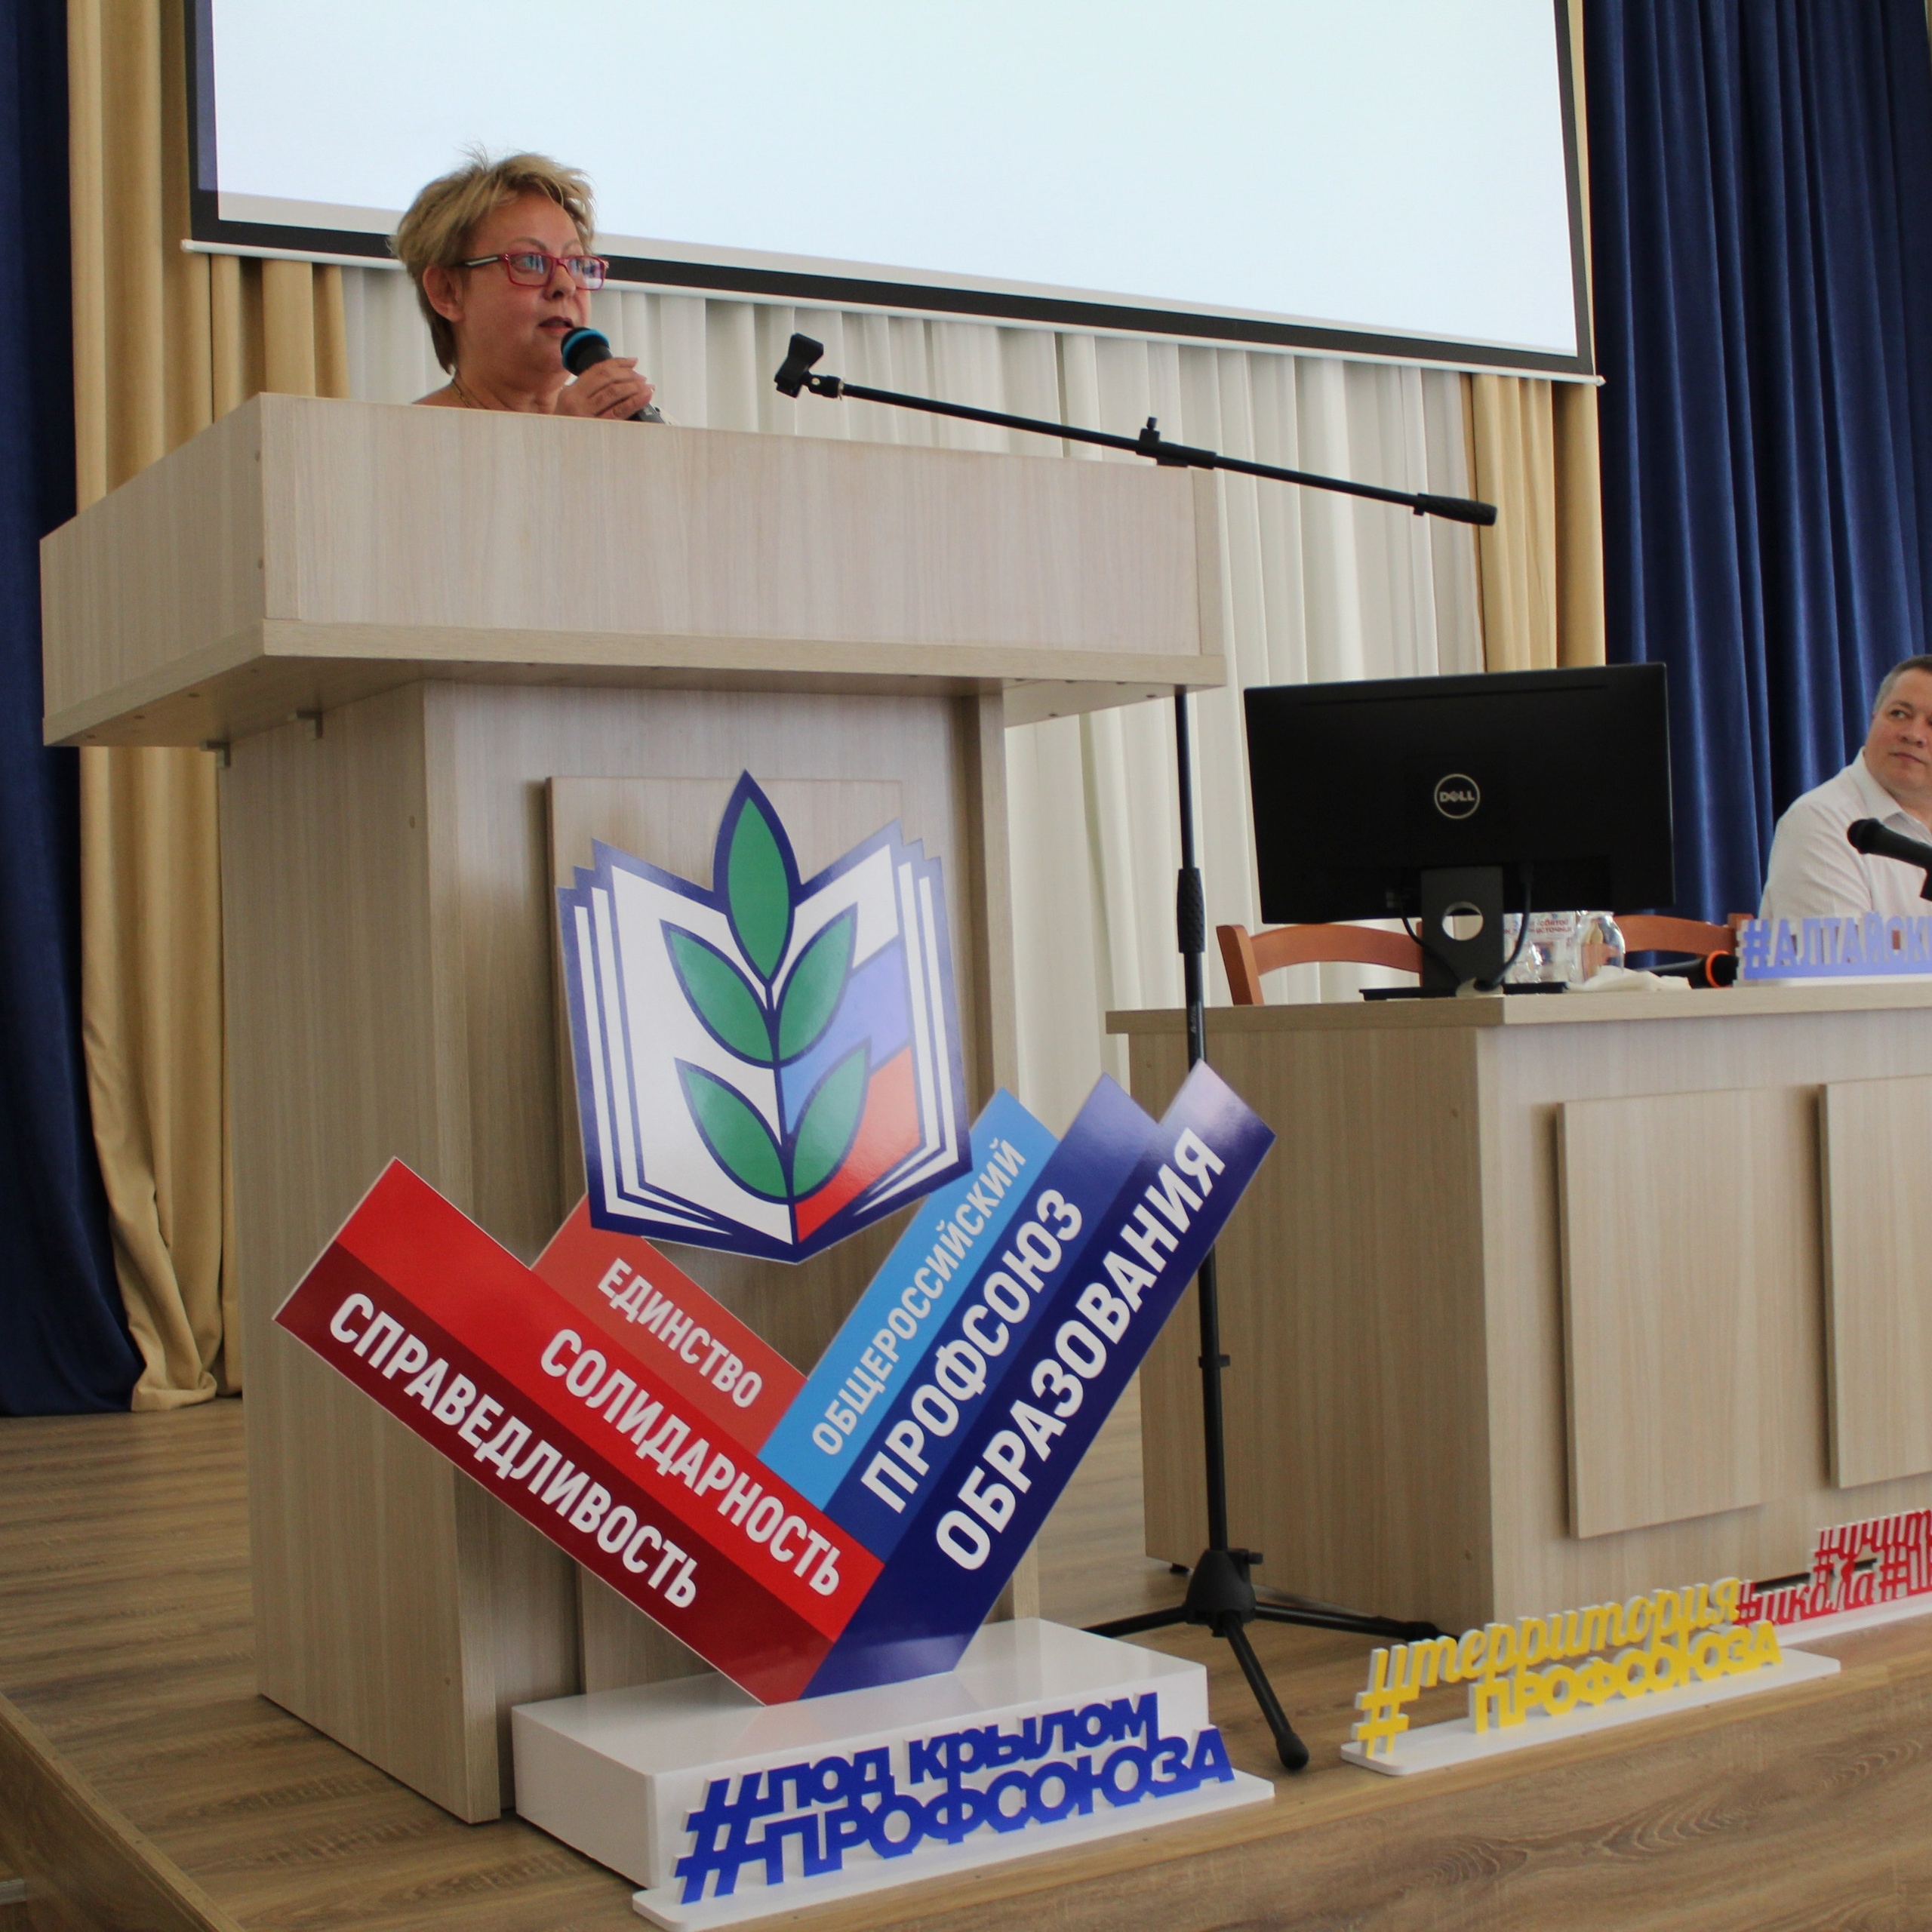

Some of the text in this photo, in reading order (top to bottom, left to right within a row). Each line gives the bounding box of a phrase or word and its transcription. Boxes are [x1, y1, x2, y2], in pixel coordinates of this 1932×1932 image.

[1439, 790, 1475, 802] DELL
[1742, 911, 1932, 979] #АЛТАЙСК
[597, 1257, 762, 1408] ЕДИНСТВО
[812, 1137, 1026, 1455] ОБЩЕРОССИЙСКИЙ
[860, 1189, 1083, 1513] ПРОФСОЮЗ
[936, 1128, 1226, 1571] ОБРАЗОВАНИЯ
[329, 1293, 697, 1609] СПРАВЕДЛИВОСТЬ
[540, 1328, 841, 1598] СОЛИДАРНОСТЬ
[908, 1692, 1159, 1786] крылом
[1472, 1620, 1783, 1734] ПРОФСОЮЗА
